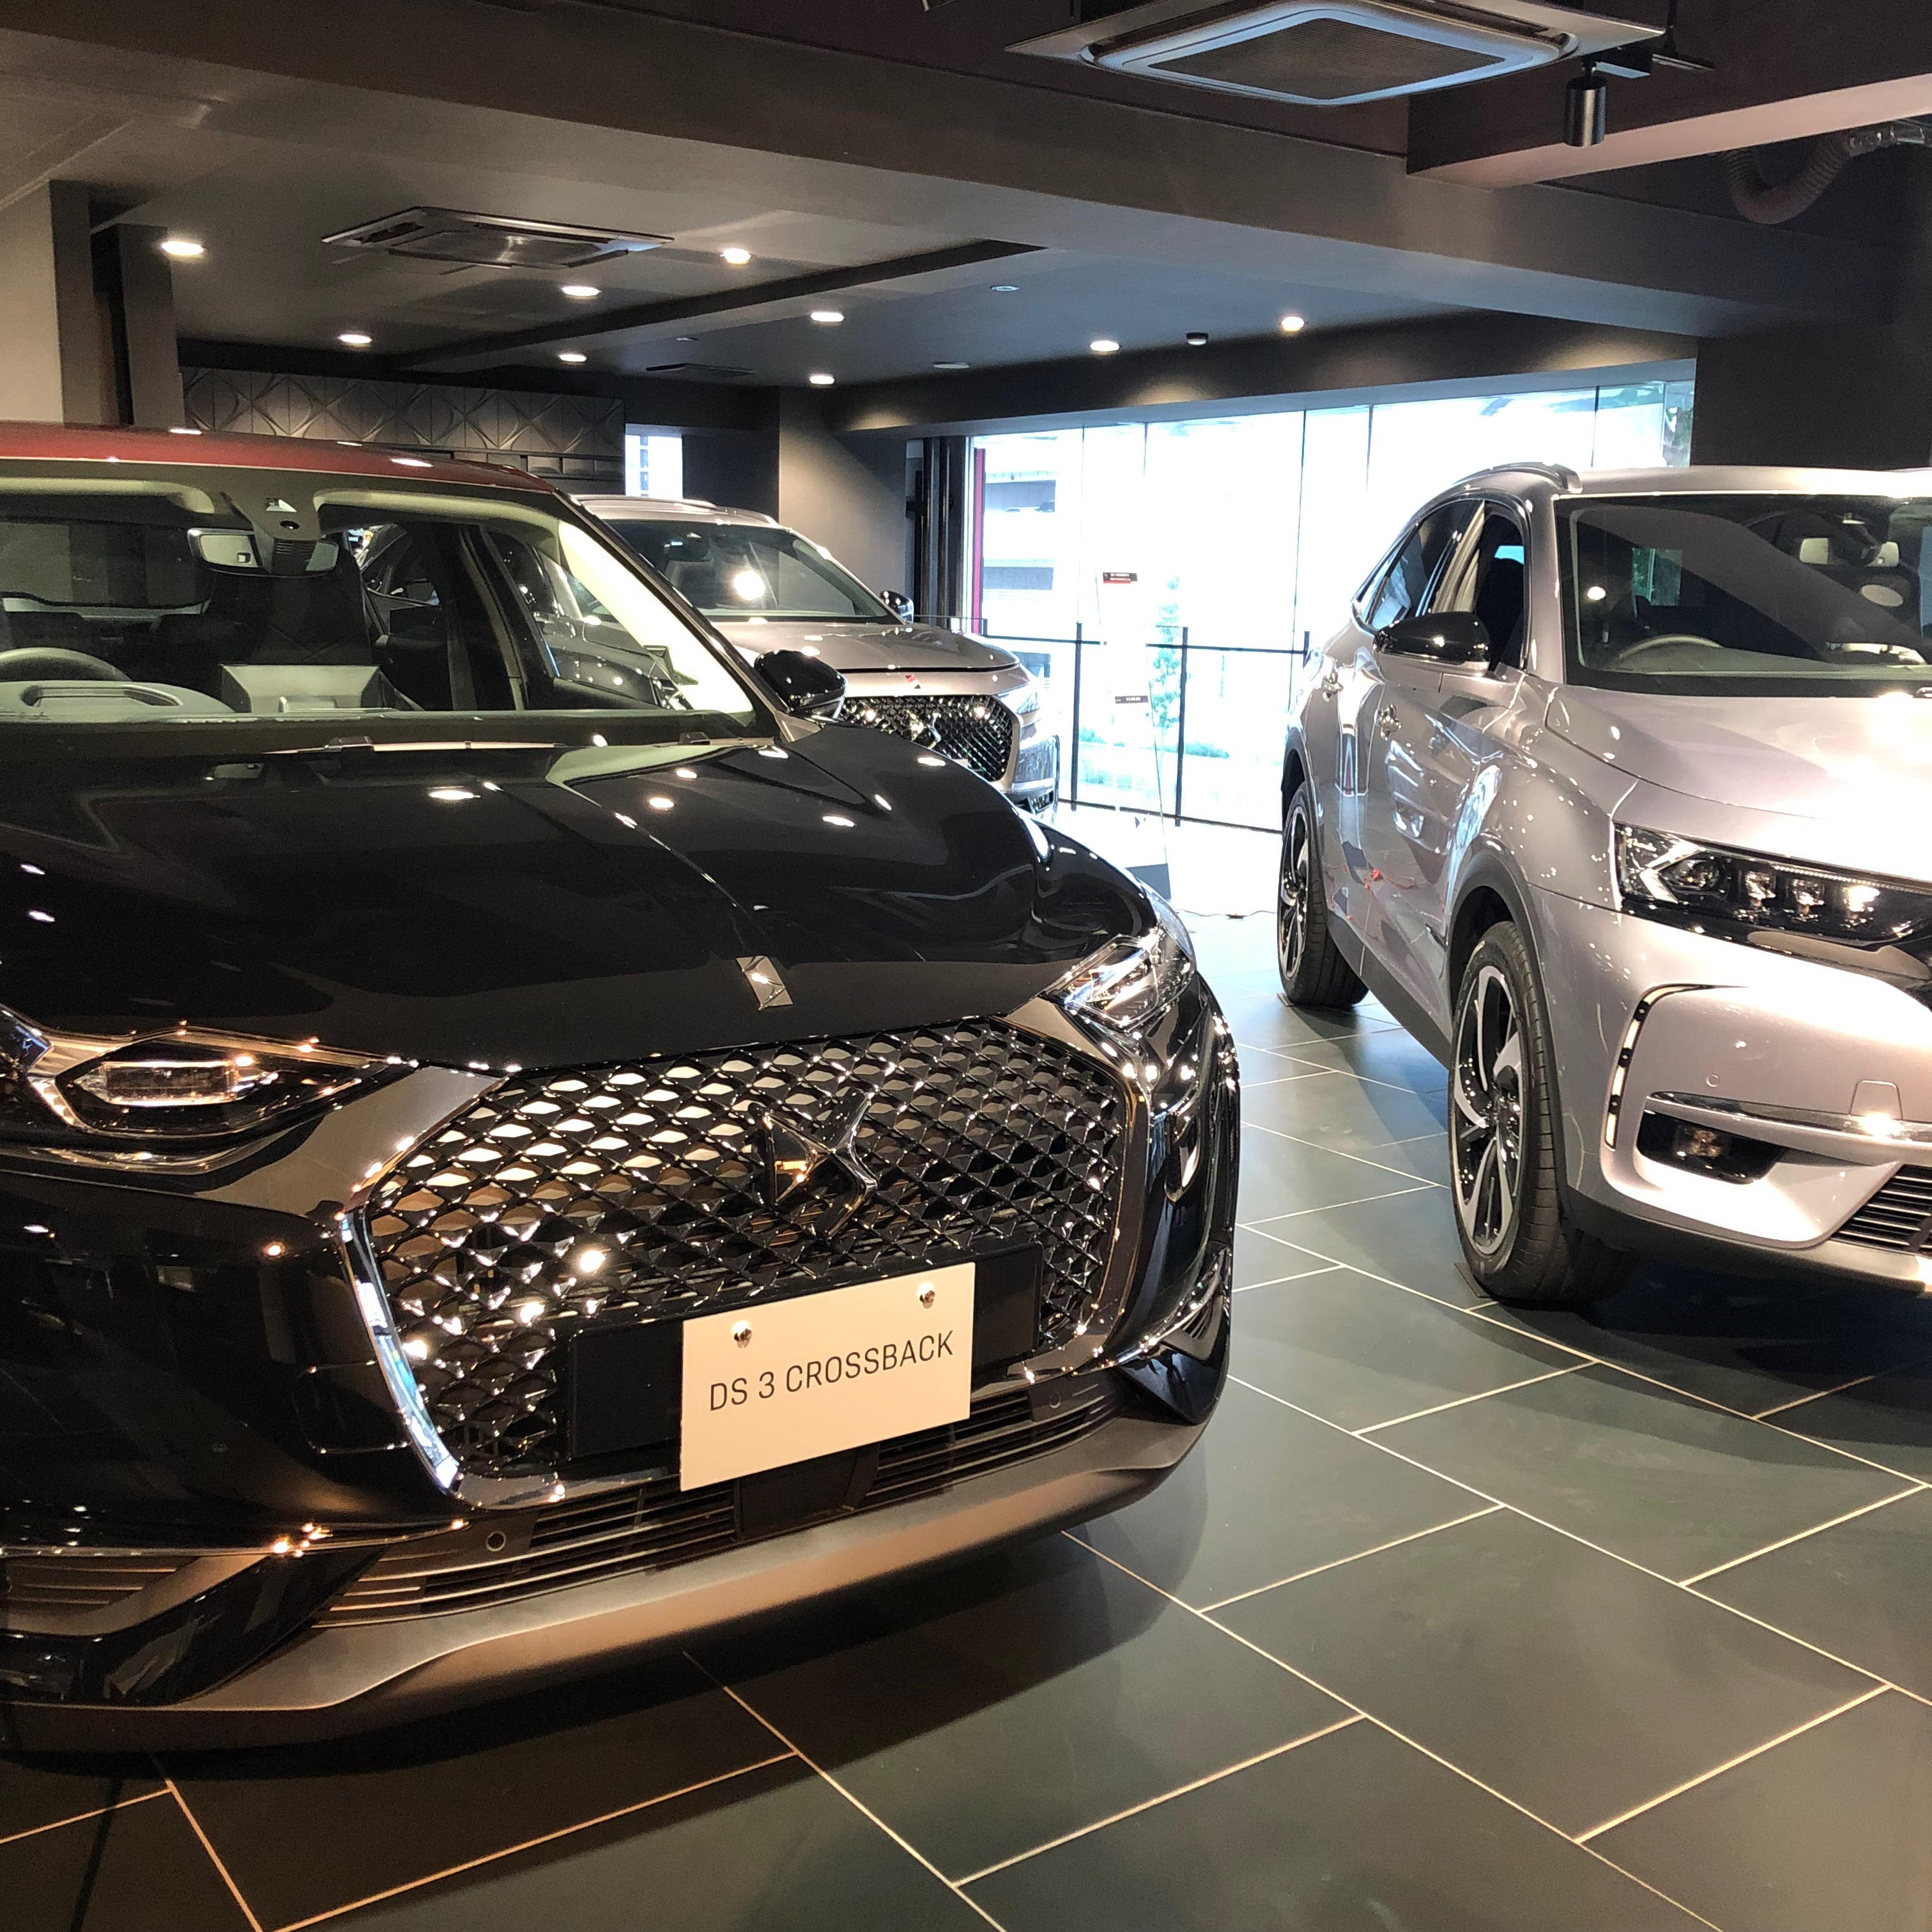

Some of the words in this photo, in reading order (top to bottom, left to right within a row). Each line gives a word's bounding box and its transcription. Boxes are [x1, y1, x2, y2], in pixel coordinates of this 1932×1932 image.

[710, 1377, 747, 1411] DS
[758, 1371, 775, 1399] 3
[786, 1330, 953, 1392] CROSSBACK
